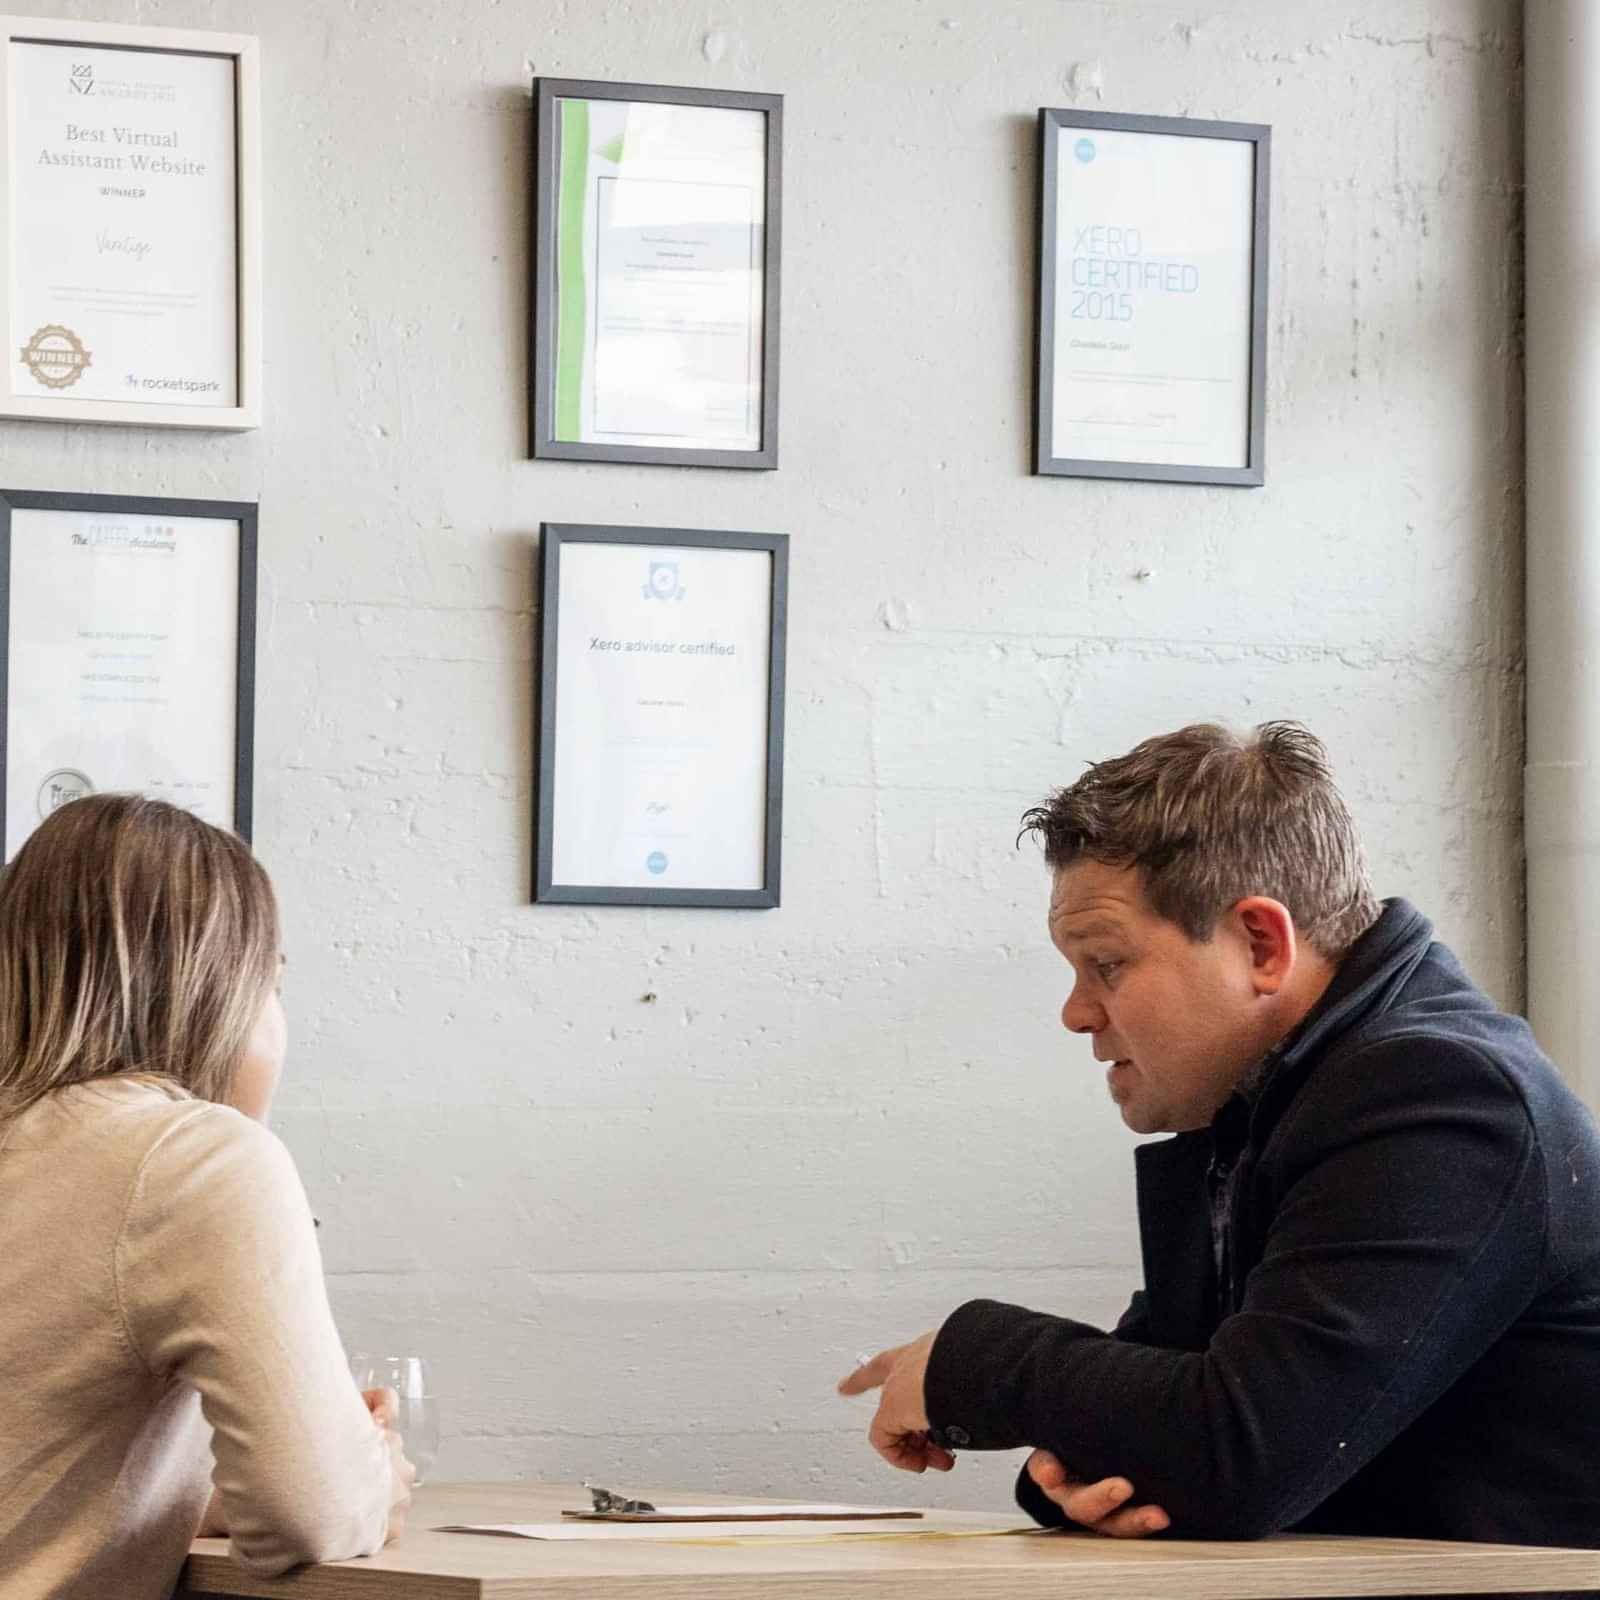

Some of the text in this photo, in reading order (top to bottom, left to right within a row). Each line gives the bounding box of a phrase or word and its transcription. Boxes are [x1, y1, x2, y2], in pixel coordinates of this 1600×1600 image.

[65, 123, 178, 149] Best Virtual
[38, 148, 207, 177] Assistant Website
[100, 186, 146, 199] WINNER
[1072, 225, 1142, 257] XERO
[1070, 256, 1199, 294] CERTIFIED
[1070, 289, 1135, 322] 2015
[30, 350, 82, 366] WINNER
[142, 376, 222, 393] rocketspark
[590, 637, 736, 656] Xero advisor certified
